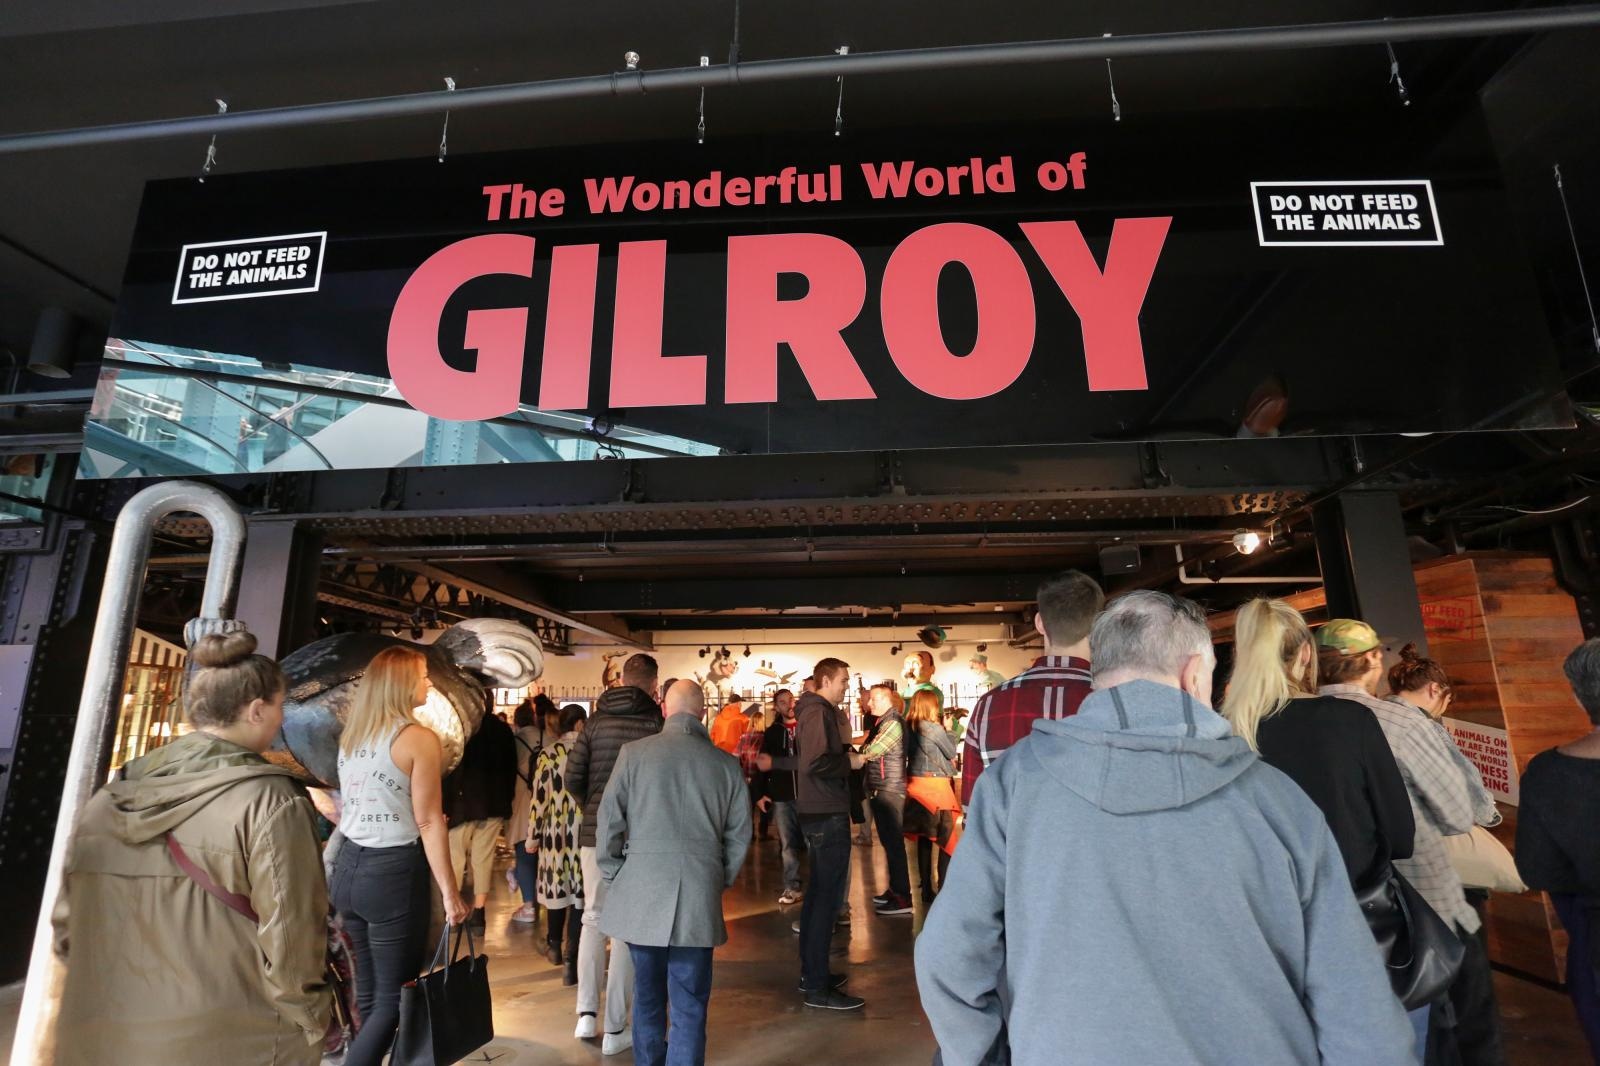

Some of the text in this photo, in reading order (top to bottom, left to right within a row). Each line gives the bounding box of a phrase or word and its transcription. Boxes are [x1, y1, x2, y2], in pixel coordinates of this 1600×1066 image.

[484, 152, 1087, 221] The Wonderful World of
[1269, 194, 1418, 211] DO NOT FEED
[1271, 213, 1421, 231] THE ANIMALS
[192, 245, 311, 271] DO NOT FEED
[189, 263, 308, 289] THE ANIMALS
[388, 217, 1172, 420] GILROY
[1440, 605, 1465, 618] FEED
[1454, 728, 1491, 745] ANIMALS
[1494, 737, 1507, 749] ON
[1468, 742, 1483, 752] ARE
[1485, 746, 1508, 758] FROM
[1480, 754, 1508, 768] WORLD
[1473, 761, 1508, 780] NNESS
[1482, 776, 1509, 794] SING
